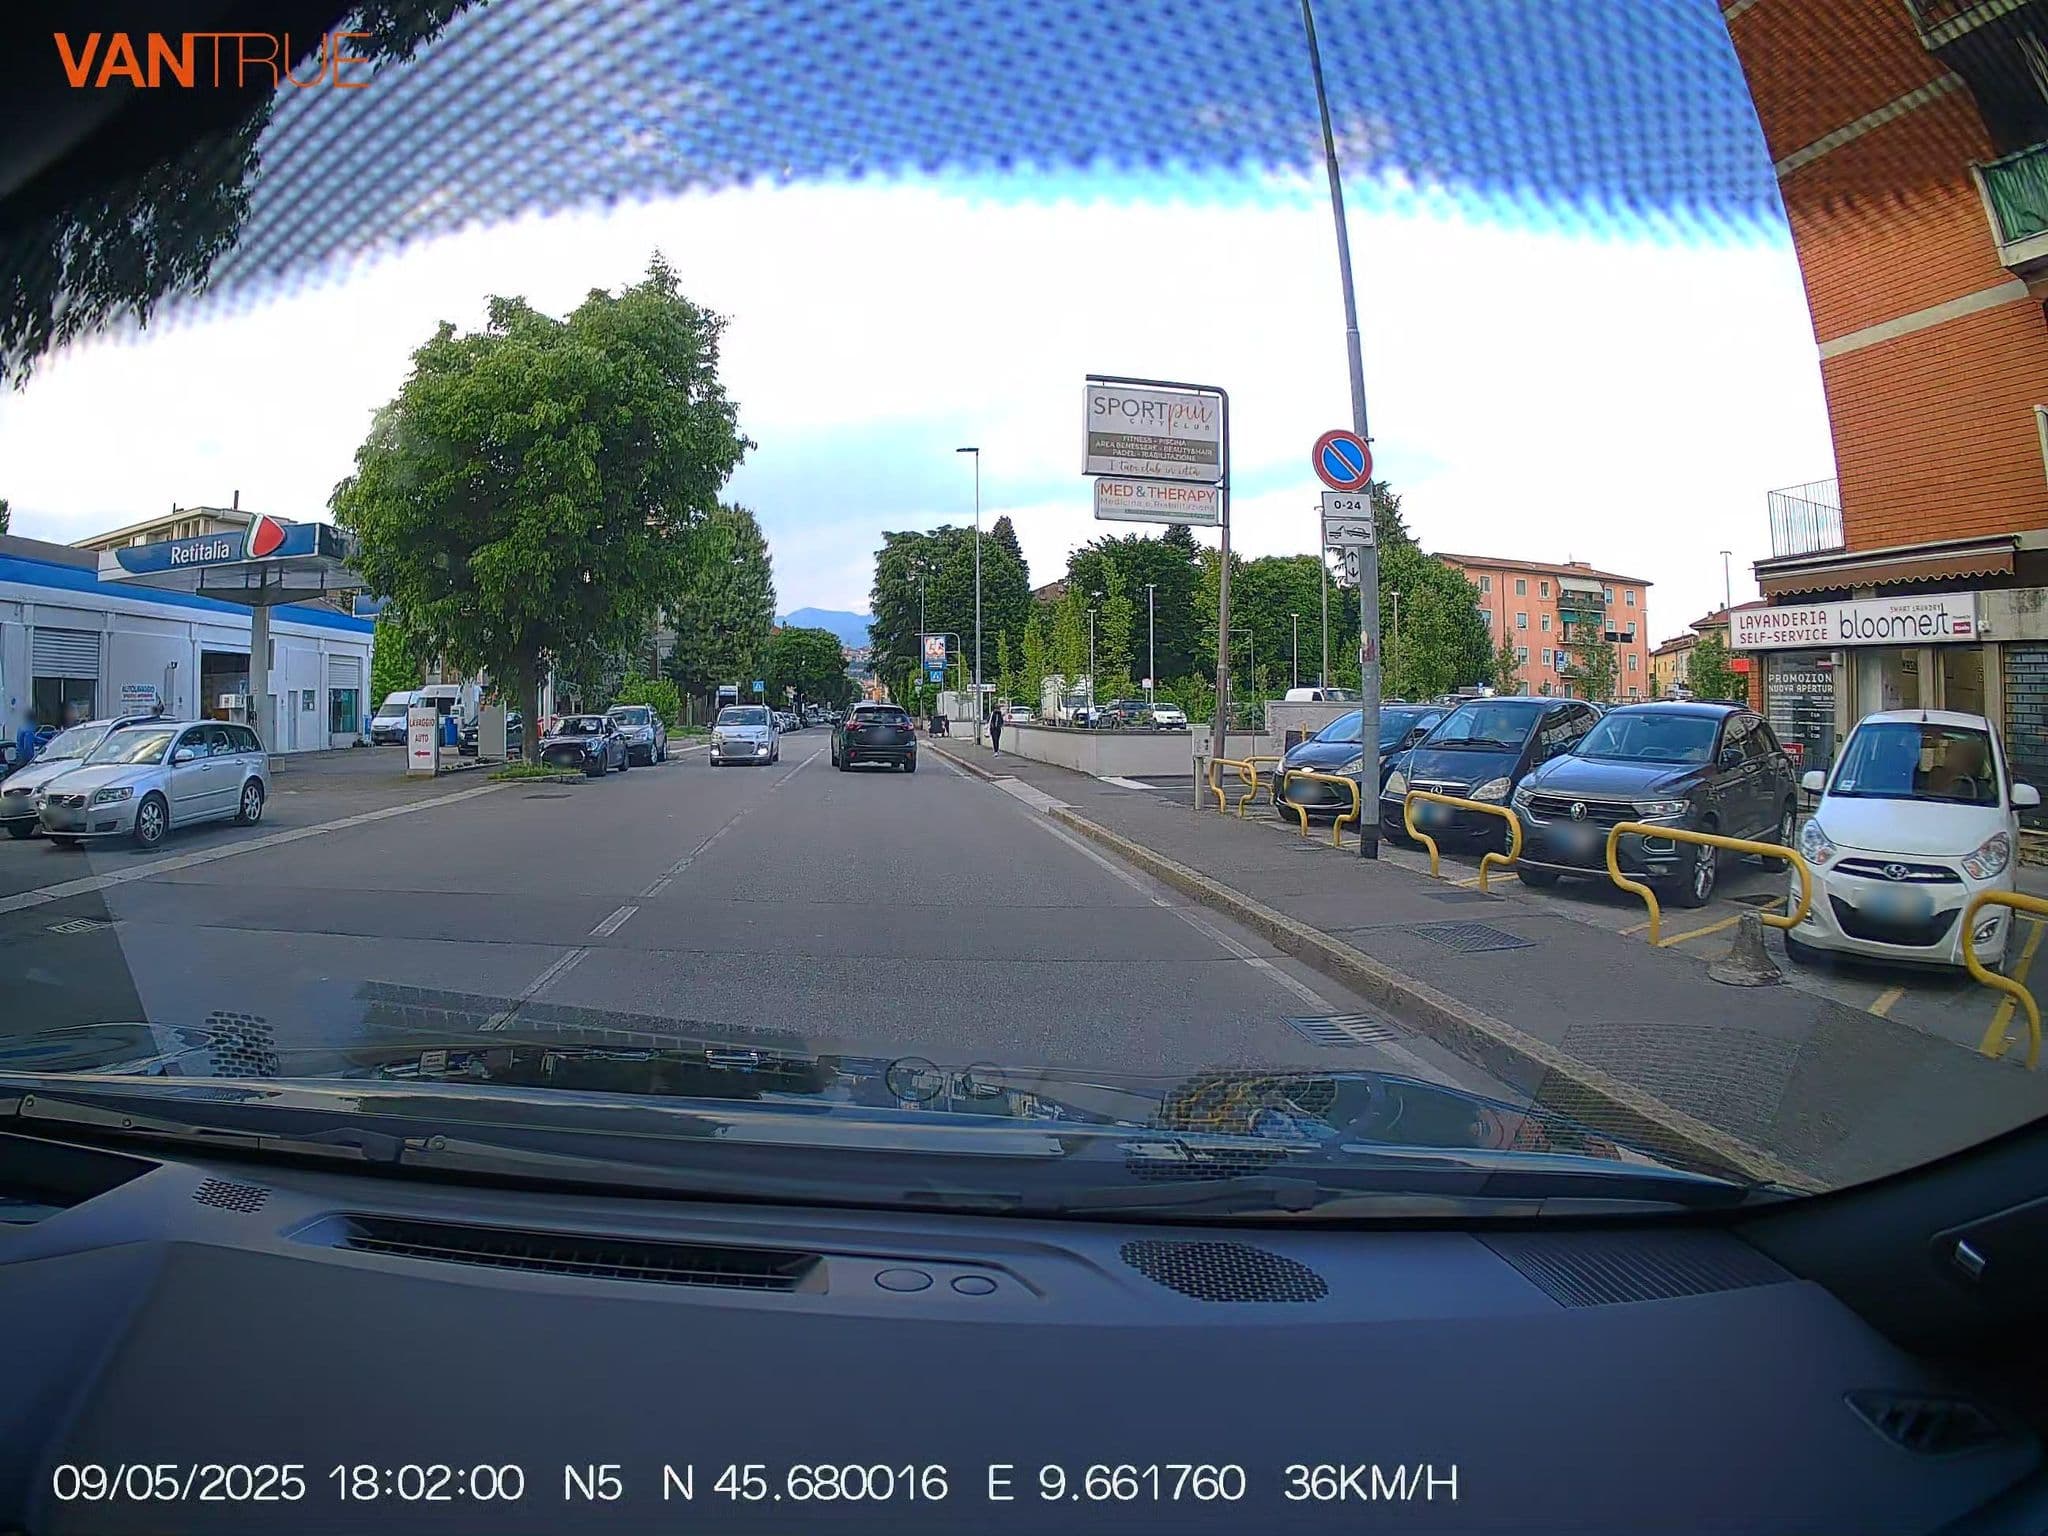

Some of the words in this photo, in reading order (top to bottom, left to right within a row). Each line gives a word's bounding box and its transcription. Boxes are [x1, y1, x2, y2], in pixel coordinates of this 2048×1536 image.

[1130, 419, 1165, 427] CITY
[1173, 422, 1210, 431] CLUB
[1100, 483, 1134, 497] MED
[1136, 485, 1146, 498] &
[1147, 486, 1216, 503] THERAPY
[1334, 500, 1361, 510] 0-24
[171, 540, 230, 565] Retitalia
[1739, 610, 1828, 630] LAVANDERIA
[1840, 602, 1950, 640] bloomest
[1740, 628, 1829, 644] SELF-SERVICE
[1768, 673, 1833, 683] PROMOZION
[1768, 684, 1794, 693] NUOVA
[1796, 684, 1834, 693] APERTUR
